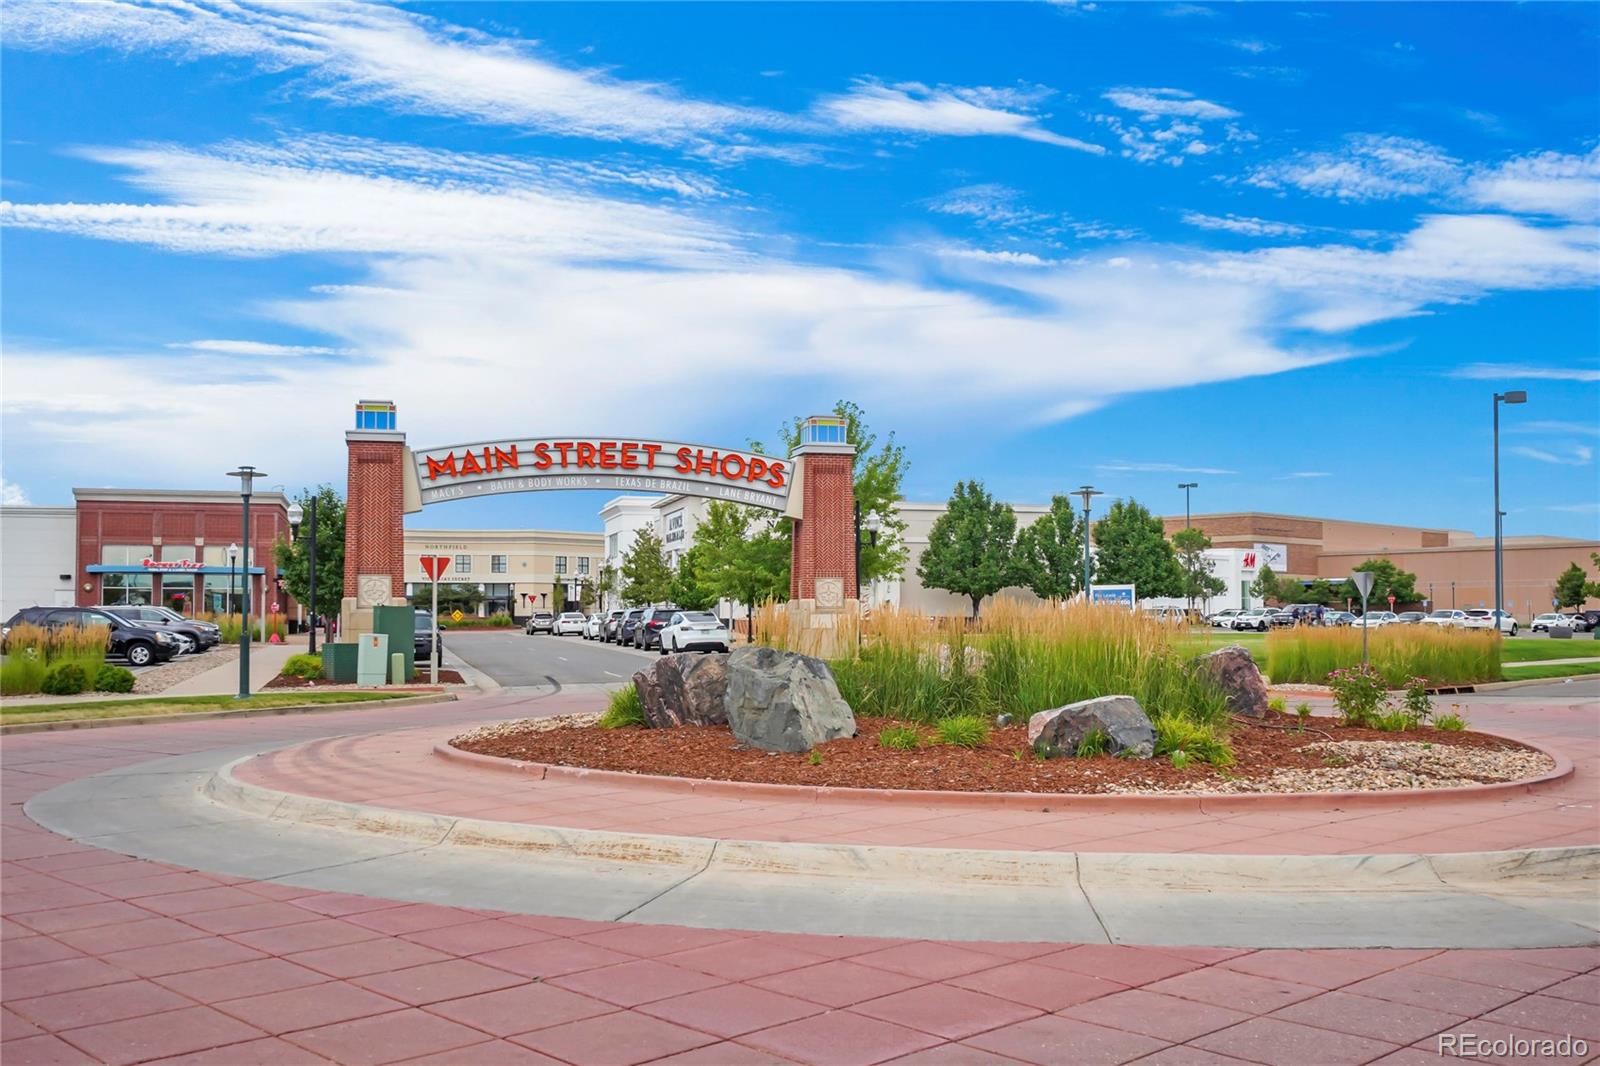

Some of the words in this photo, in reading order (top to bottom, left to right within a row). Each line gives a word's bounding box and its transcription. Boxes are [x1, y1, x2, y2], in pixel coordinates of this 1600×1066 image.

[426, 444, 519, 481] MAIN
[534, 441, 662, 471] STREET
[674, 446, 786, 489] SHOPS
[431, 486, 464, 499] MACY'S
[490, 481, 515, 491] BATH
[518, 480, 525, 488] &
[528, 478, 553, 488] BODY
[555, 477, 588, 487] WORKS
[615, 477, 642, 488] TEXAS
[645, 478, 657, 488] DE
[660, 480, 691, 492] BRAZIL
[719, 487, 742, 498] LANE
[743, 490, 777, 506] BRYANT
